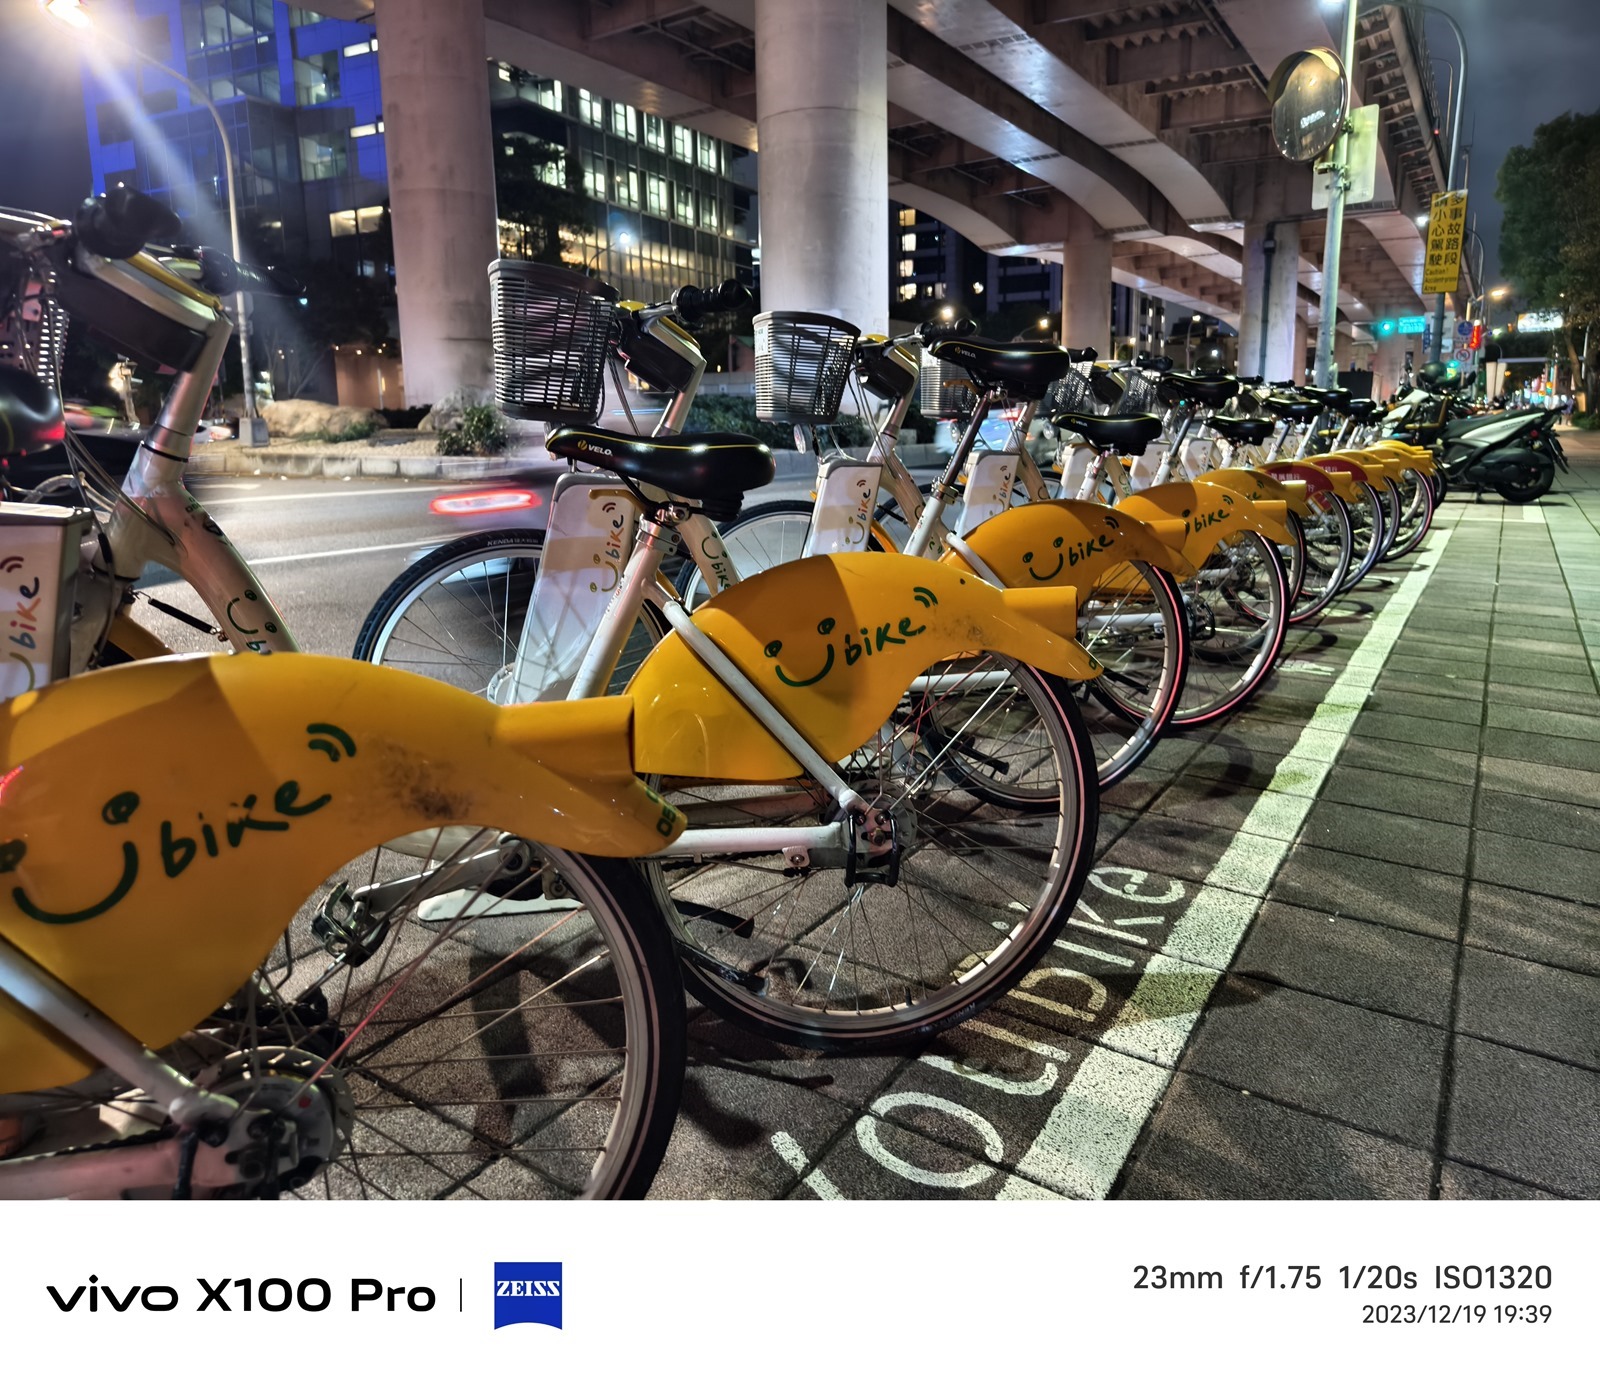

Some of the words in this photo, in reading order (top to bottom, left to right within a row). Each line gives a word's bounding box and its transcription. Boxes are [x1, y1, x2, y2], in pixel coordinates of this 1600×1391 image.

[1443, 194, 1464, 266] 多事故路段
[587, 444, 612, 457] VELO
